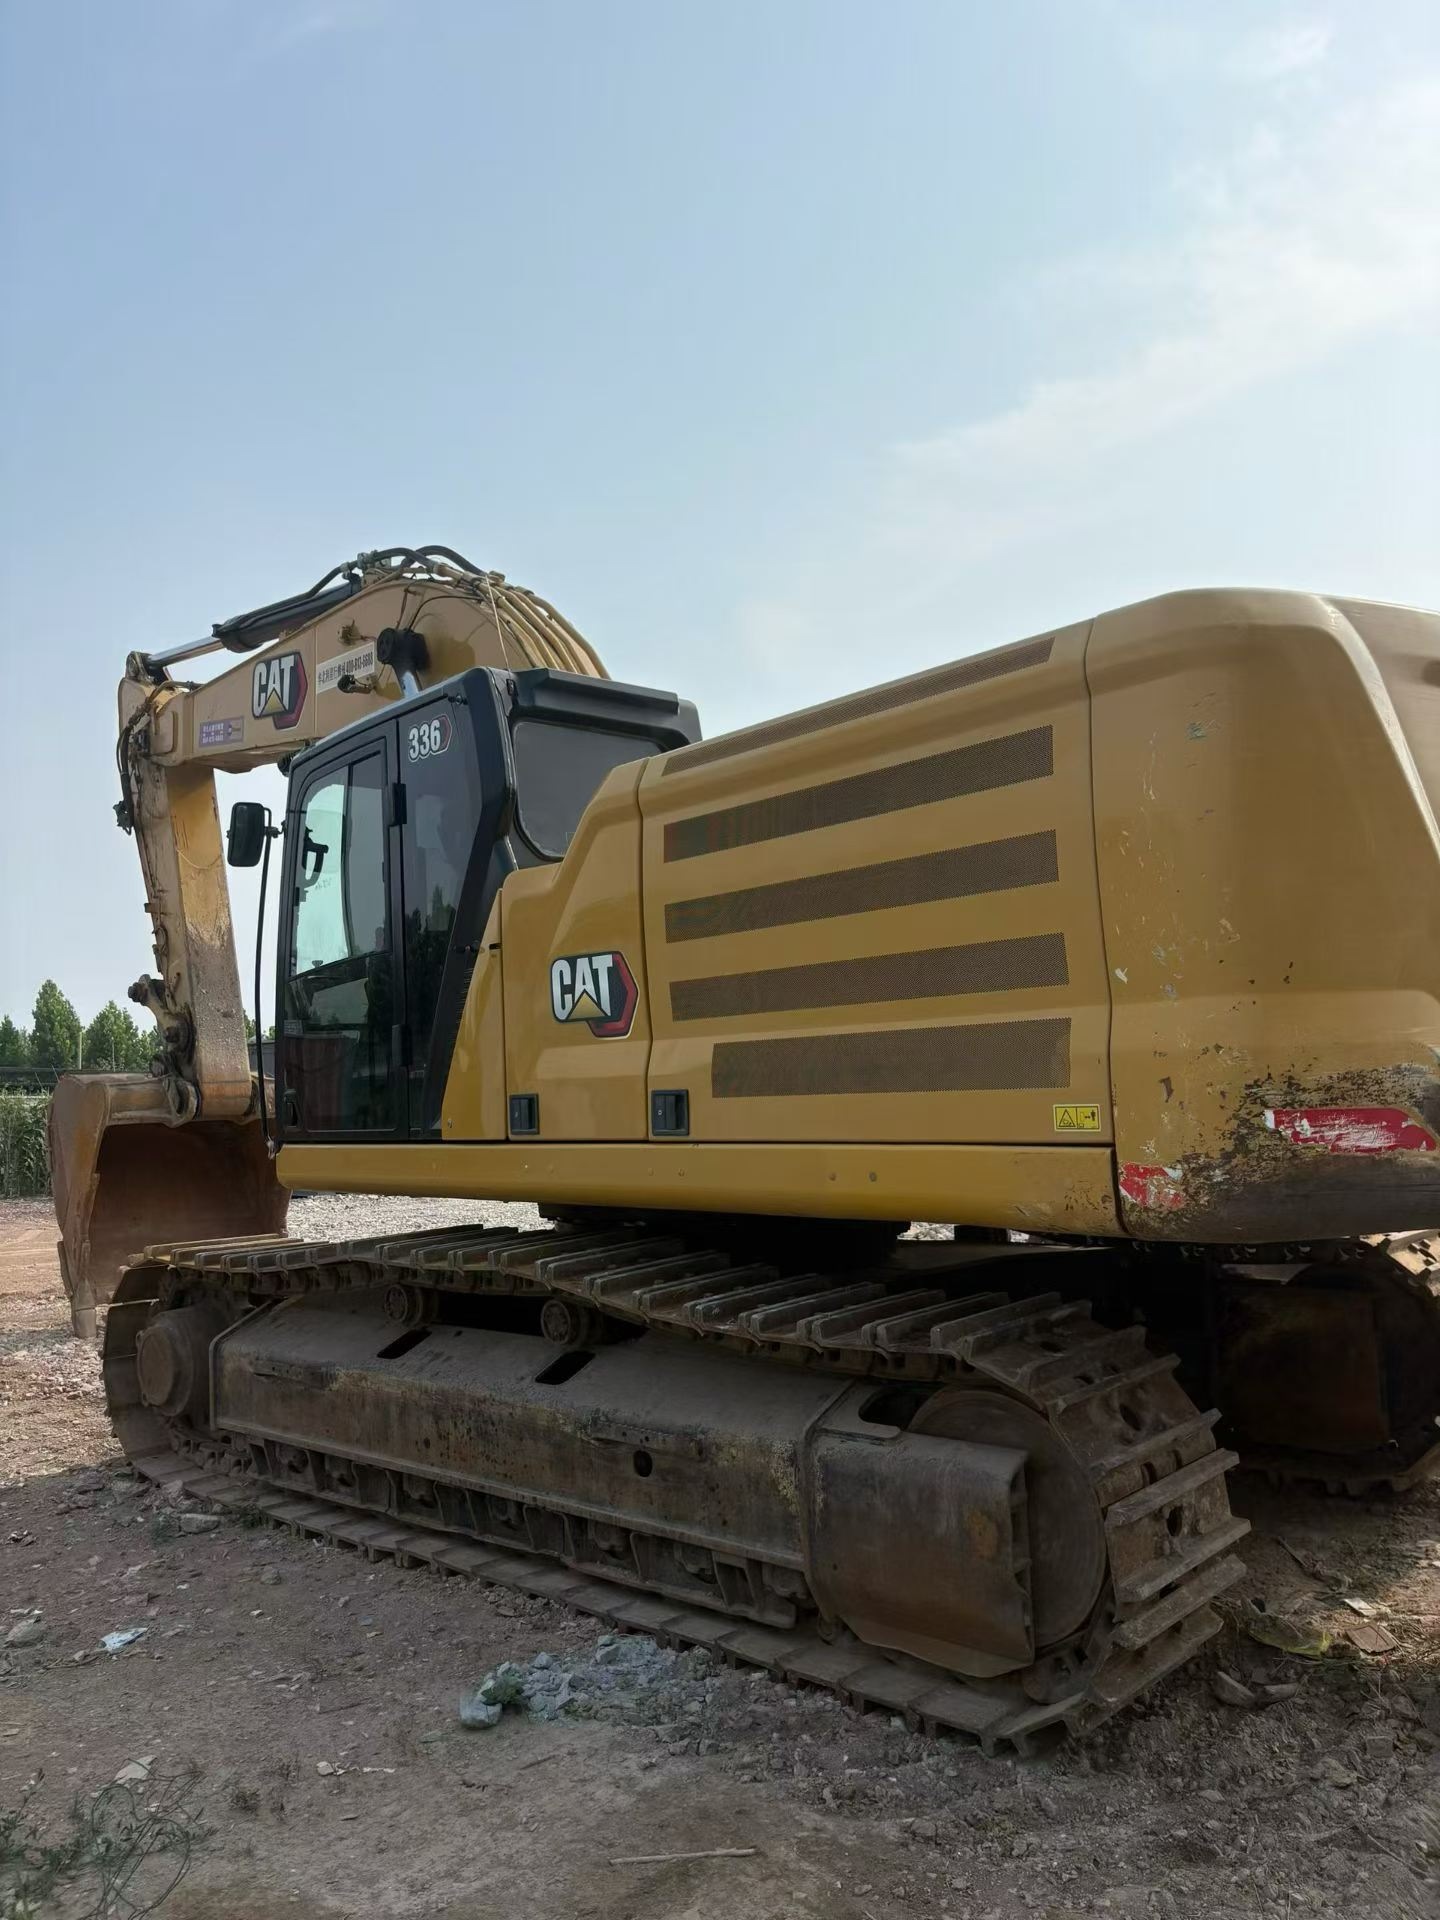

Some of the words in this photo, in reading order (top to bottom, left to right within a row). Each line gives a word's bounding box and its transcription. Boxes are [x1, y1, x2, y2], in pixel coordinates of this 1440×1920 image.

[253, 654, 295, 718] CAT
[409, 719, 441, 759] 336
[551, 953, 613, 1020] CAT
